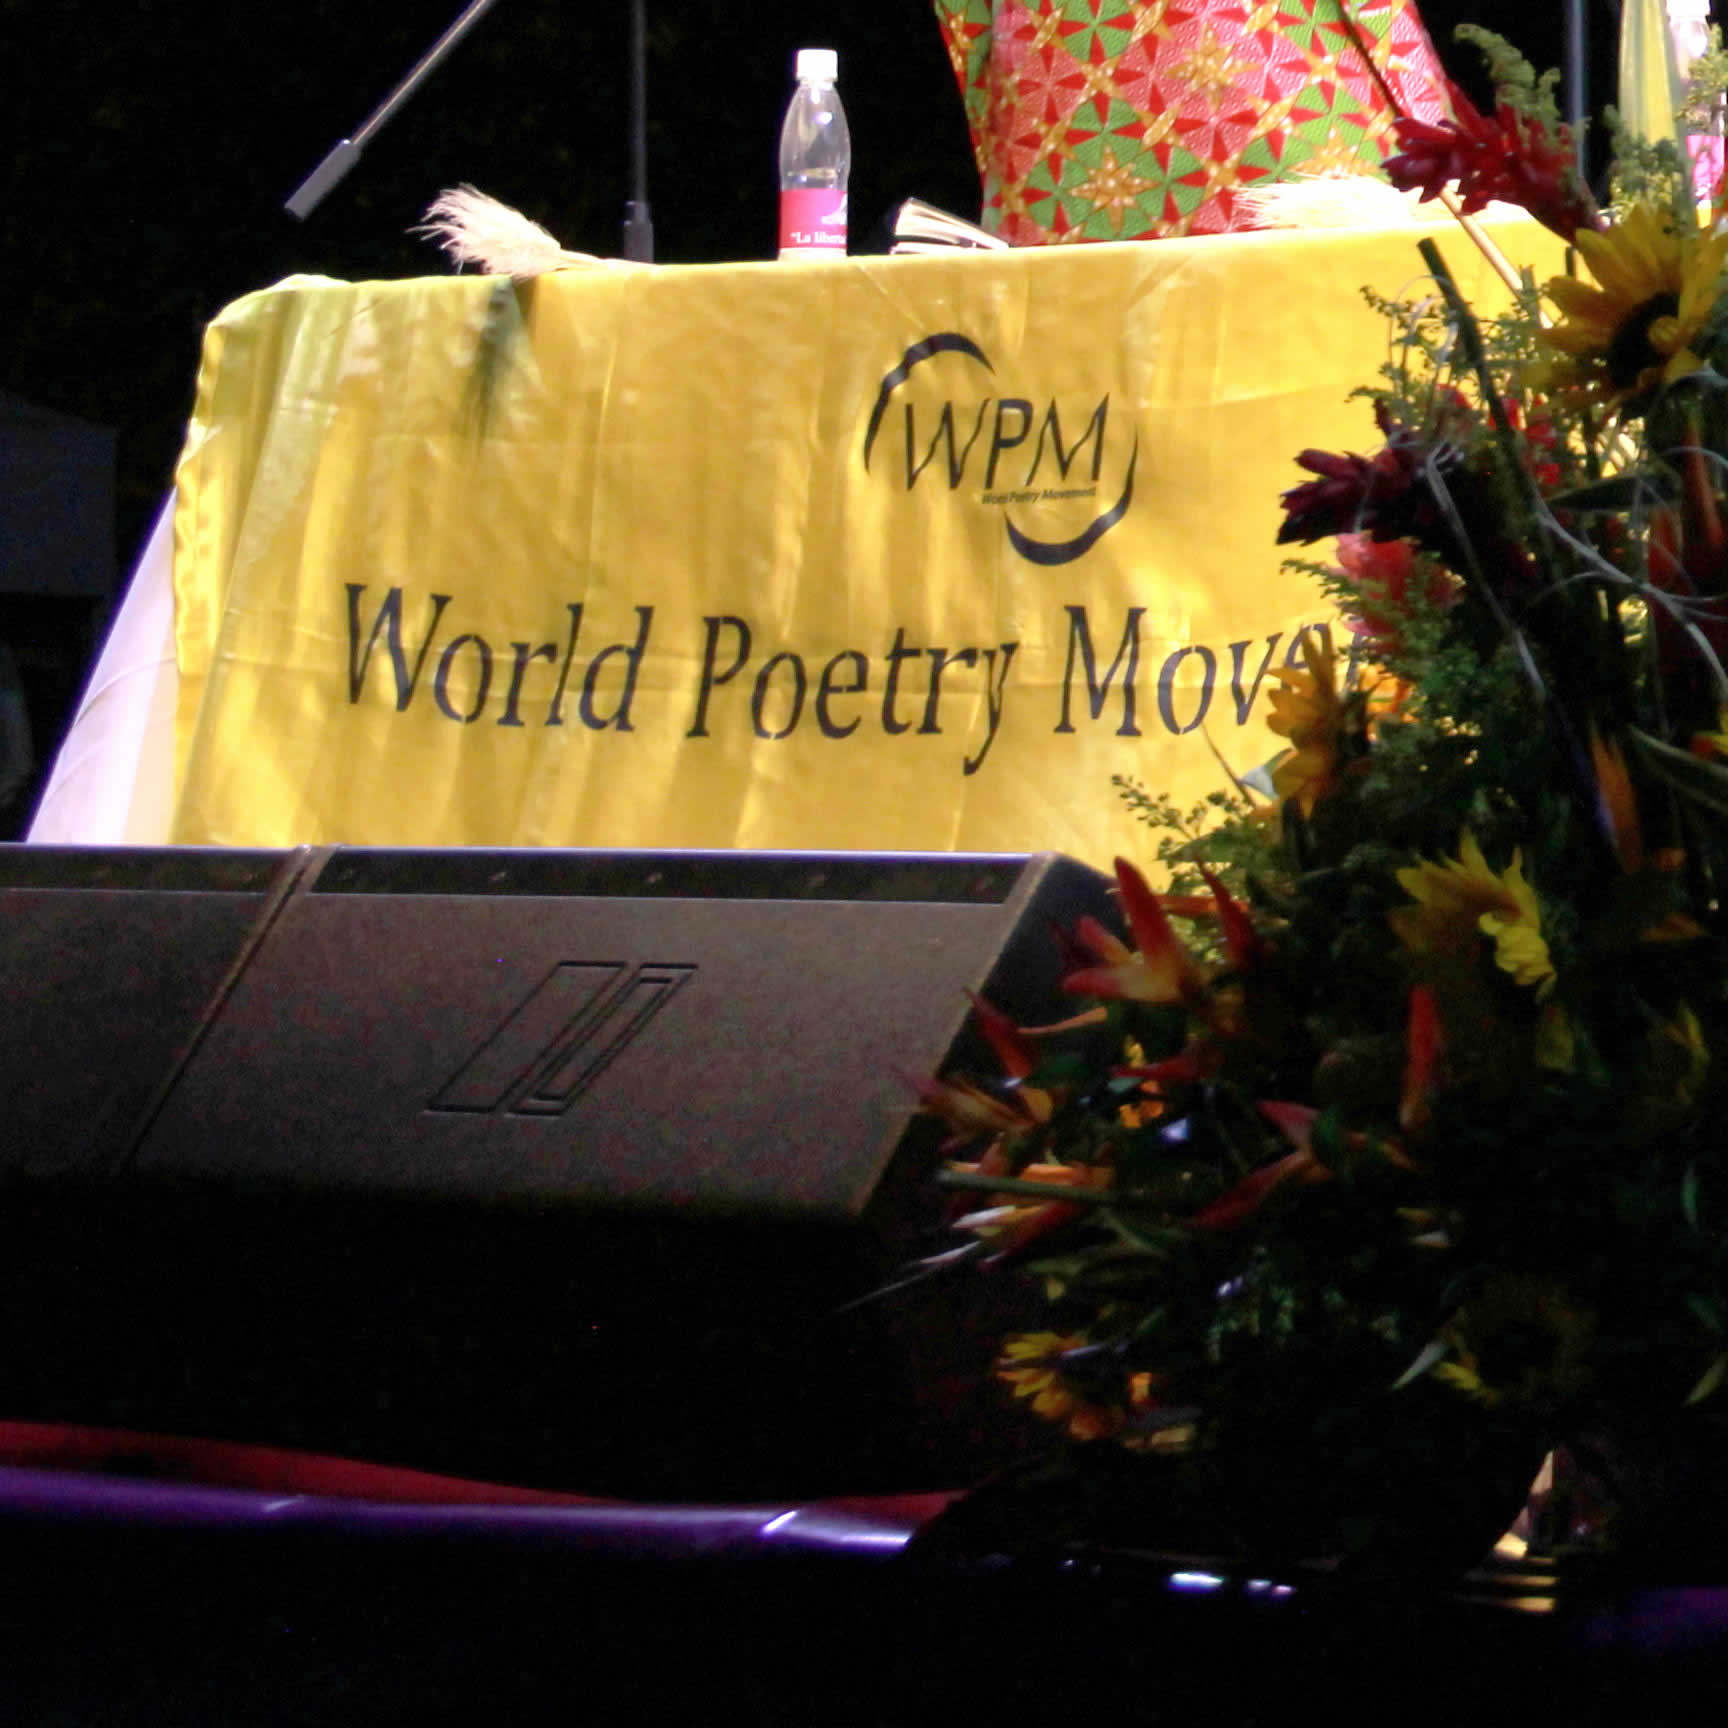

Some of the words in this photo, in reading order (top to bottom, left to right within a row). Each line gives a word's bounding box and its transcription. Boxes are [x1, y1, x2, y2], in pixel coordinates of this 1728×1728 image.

[905, 392, 1110, 491] WPM
[344, 582, 655, 733] World
[685, 614, 1020, 777] Poetry
